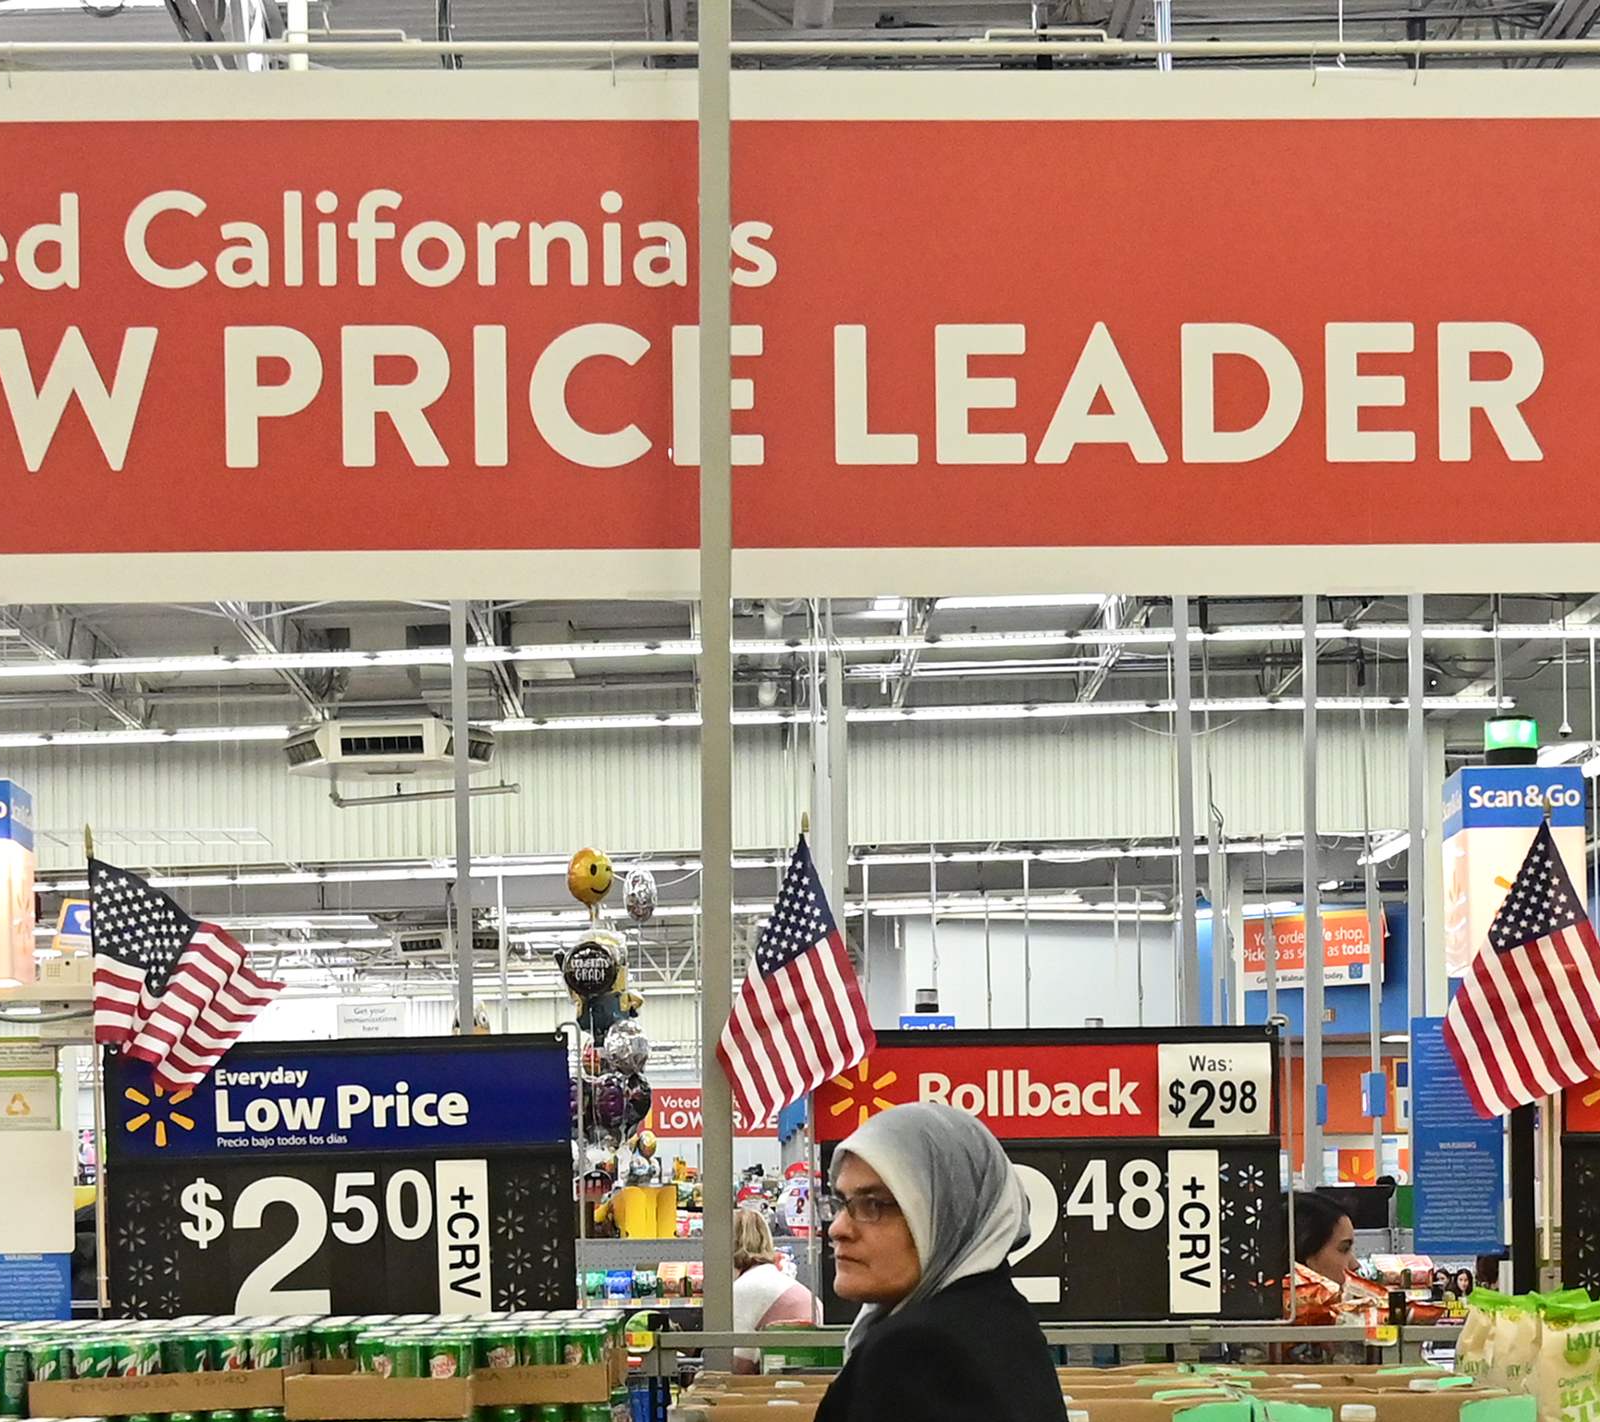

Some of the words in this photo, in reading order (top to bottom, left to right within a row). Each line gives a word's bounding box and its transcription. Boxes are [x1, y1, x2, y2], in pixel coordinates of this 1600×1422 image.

[123, 188, 779, 292] Californias
[224, 322, 764, 470] PRICE
[833, 320, 1545, 465] LEADER
[1469, 784, 1581, 809] Scan&Go
[1342, 942, 1370, 956] toda
[214, 1067, 309, 1089] Everyday
[660, 1096, 700, 1109] Voted
[917, 1066, 1142, 1119] Rollback
[1189, 1053, 1234, 1075] Was:
[215, 1086, 326, 1133] Low
[337, 1082, 470, 1129] Price
[216, 1135, 248, 1147] Precio
[251, 1134, 275, 1148] bajo
[277, 1134, 307, 1146] todos
[309, 1134, 324, 1145] los
[445, 1185, 483, 1300] +CRV
[1182, 1175, 1212, 1290] +CRV
